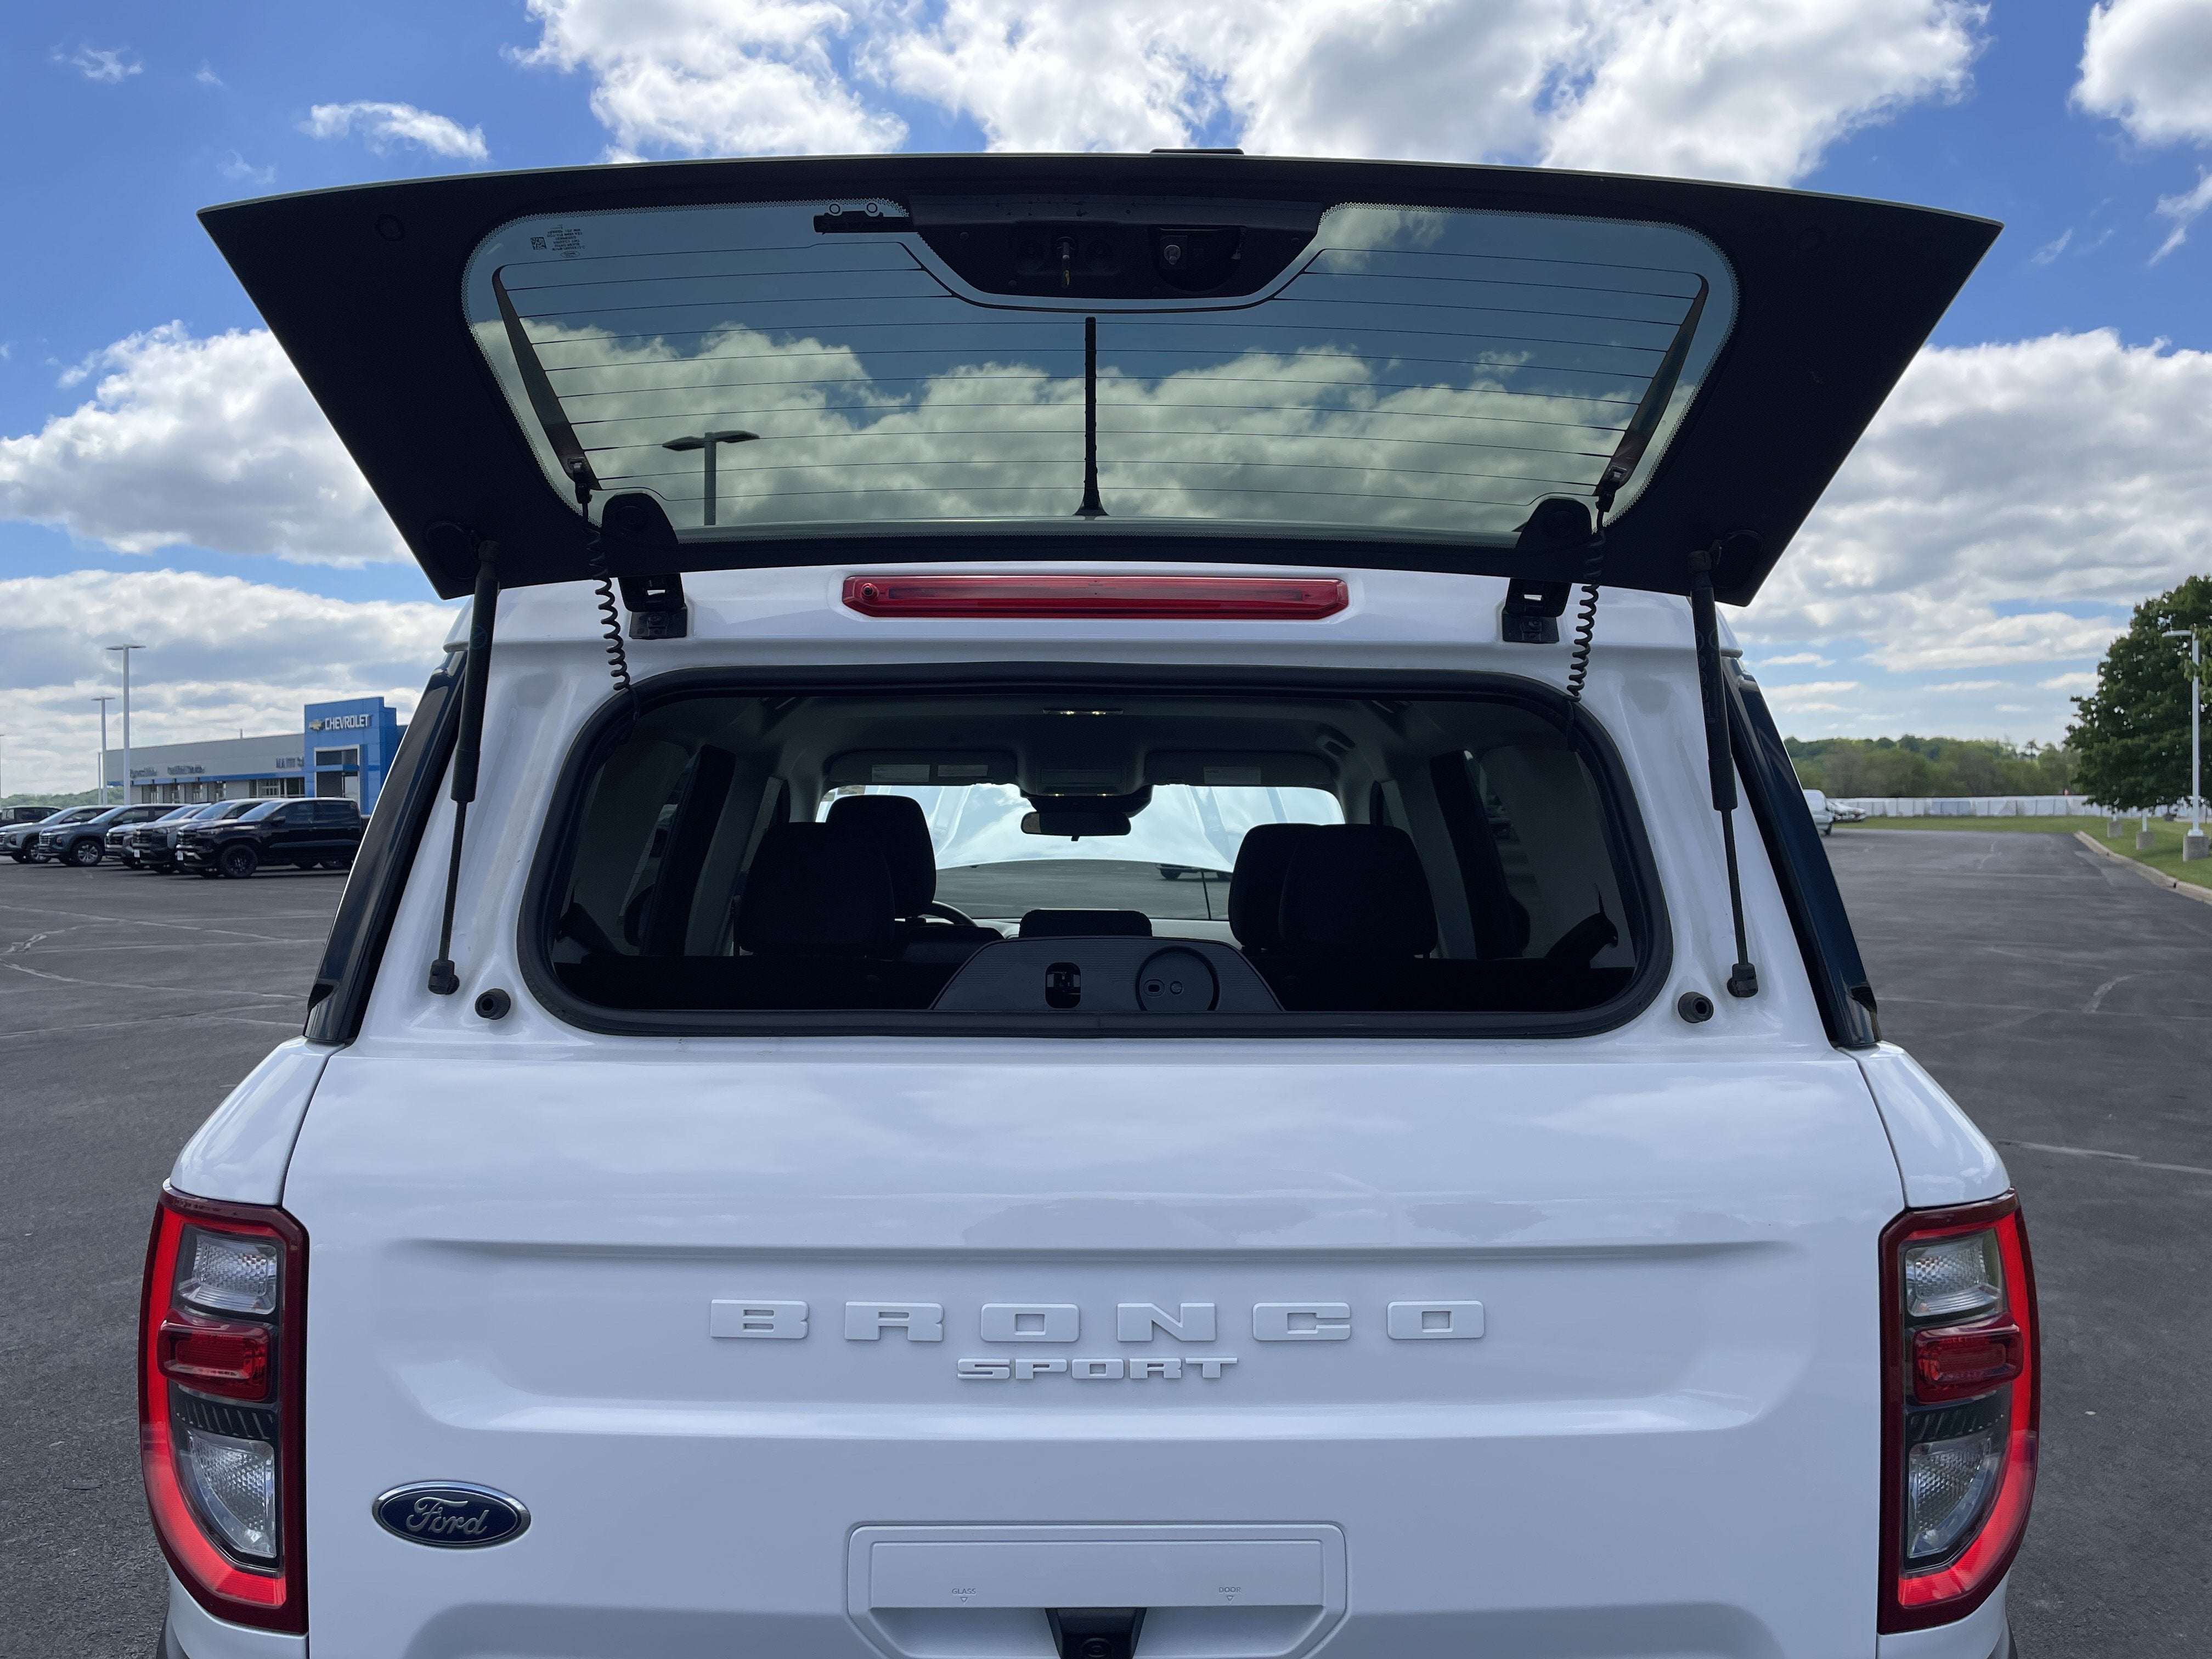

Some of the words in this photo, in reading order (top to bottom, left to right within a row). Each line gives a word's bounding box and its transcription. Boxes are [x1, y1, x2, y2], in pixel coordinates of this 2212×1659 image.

[325, 714, 369, 730] CHEVROLET
[709, 1299, 1486, 1343] BRONCO
[957, 1357, 1238, 1380] SPORT
[405, 1496, 490, 1535] Ford
